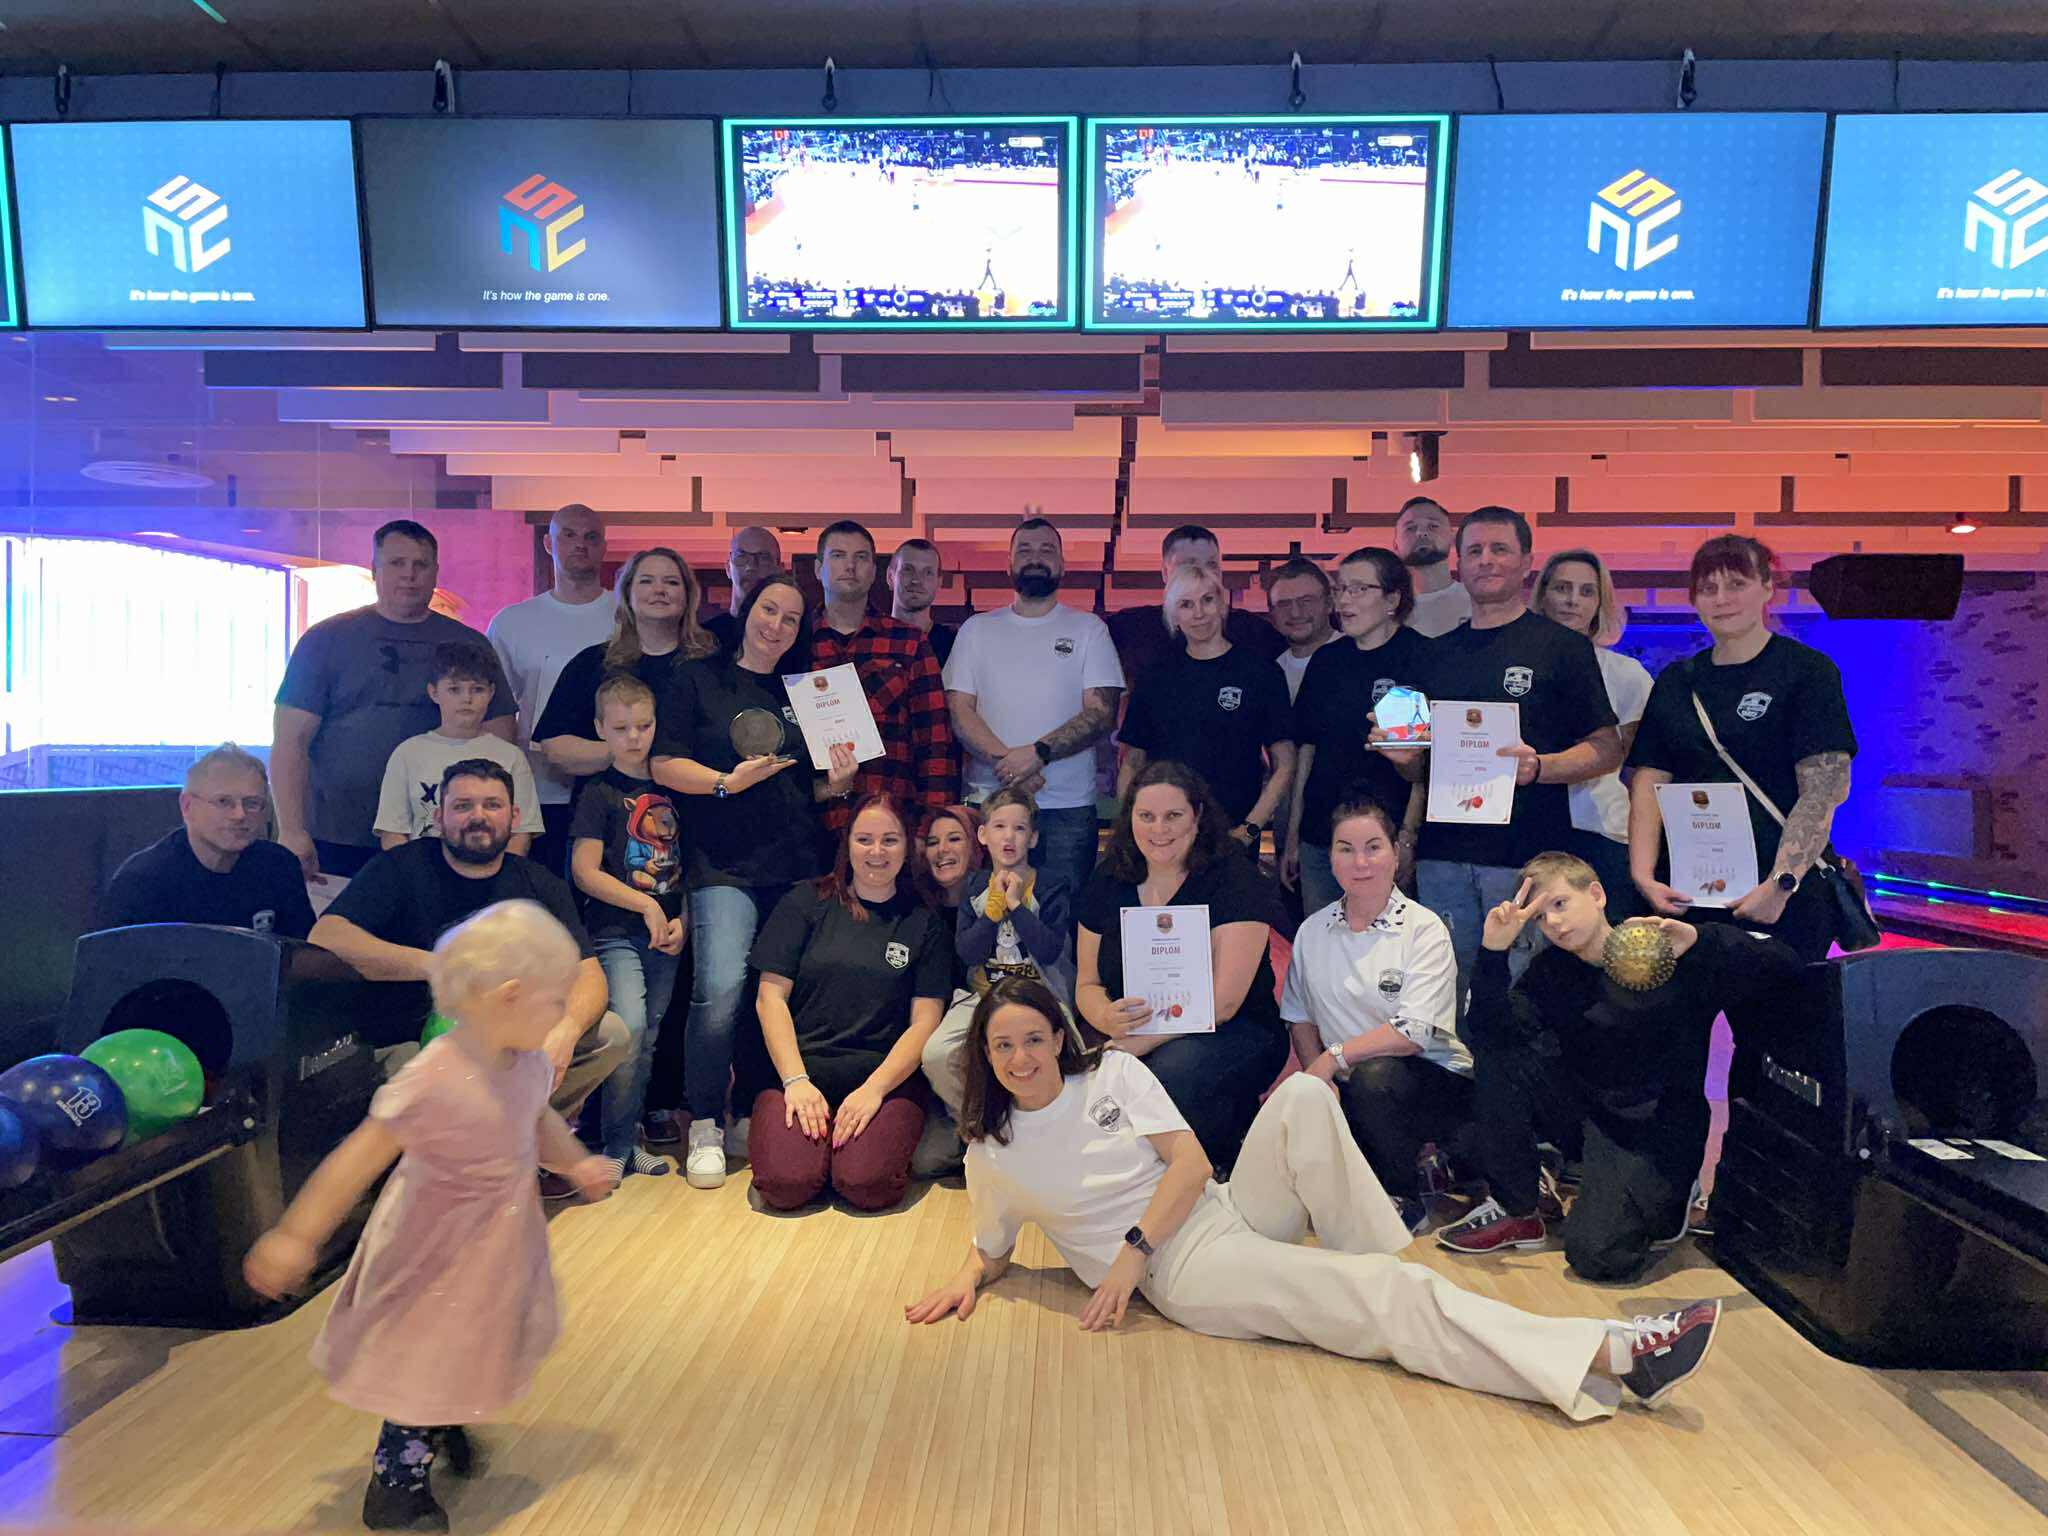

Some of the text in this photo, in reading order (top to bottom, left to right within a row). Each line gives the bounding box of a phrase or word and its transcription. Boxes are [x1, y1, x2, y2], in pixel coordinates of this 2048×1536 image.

[482, 290, 611, 303] It's how the game is one.
[1460, 739, 1489, 749] DIPLOM
[1151, 946, 1181, 955] DIPLOM
[66, 1086, 102, 1119] 13
